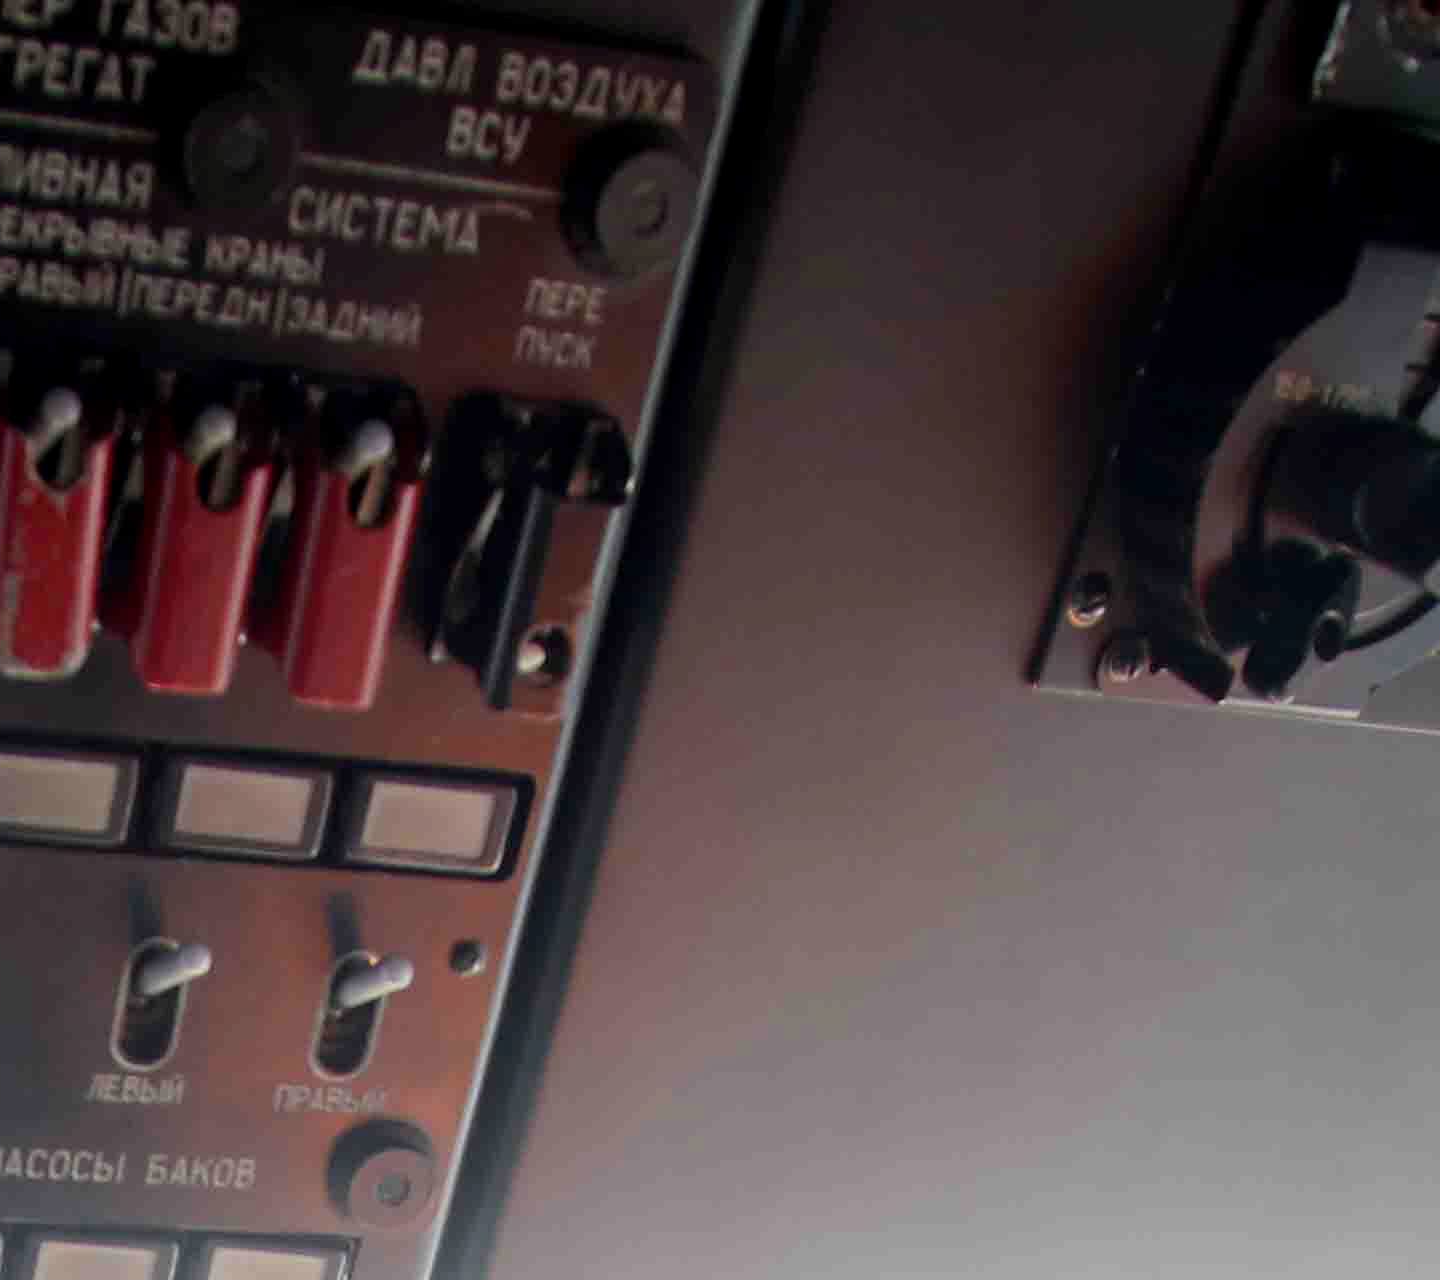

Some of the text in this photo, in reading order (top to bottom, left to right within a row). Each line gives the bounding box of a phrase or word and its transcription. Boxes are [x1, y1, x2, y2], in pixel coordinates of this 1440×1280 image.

[352, 27, 687, 127] ДАВЛ ВОЗДУХА
[444, 105, 532, 164] ВСУ
[288, 184, 480, 256] СИСТЕМА
[204, 232, 327, 287] КРАНЫ
[523, 277, 608, 327] ПЕРЕ
[513, 324, 599, 369] ПУСК
[83, 1070, 187, 1106] ЛЕВЫЙ
[273, 1082, 389, 1116] ПРАВЫЙ
[143, 1151, 257, 1190] БАКОВ
